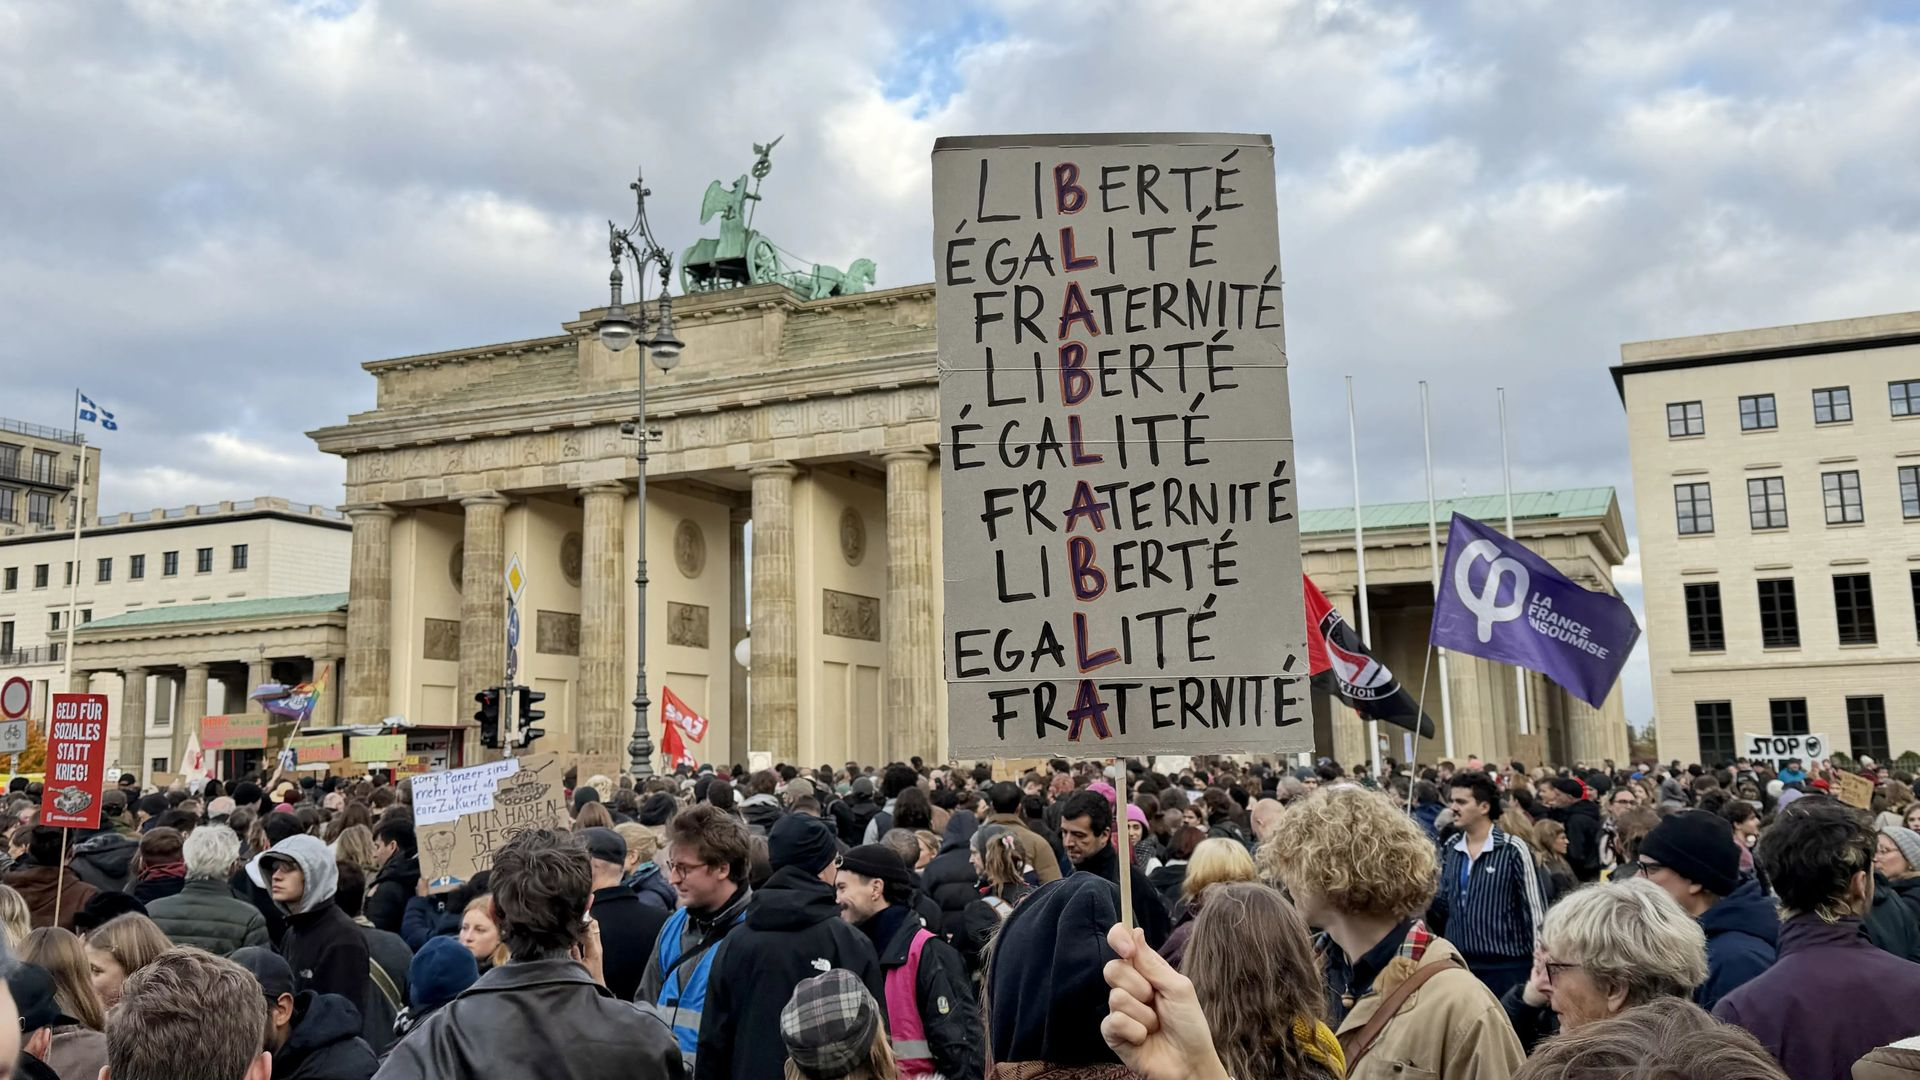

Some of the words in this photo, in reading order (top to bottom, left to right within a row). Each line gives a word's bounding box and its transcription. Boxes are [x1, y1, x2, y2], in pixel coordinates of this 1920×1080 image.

[977, 149, 1244, 223] LIBERTÉ
[946, 205, 1218, 286] ÉGALITÉ
[973, 265, 1283, 344] FRATERNITÉ
[985, 329, 1239, 407] LIBERTÉ
[951, 392, 1211, 471] ÉGALITÉ
[980, 460, 1293, 541] FRATERNITÉ
[995, 529, 1240, 603] LIBERTÉ
[1532, 592, 1552, 609] LA
[1528, 604, 1592, 638] FRANCE
[988, 654, 1303, 742] FRATERNITÉ
[1340, 681, 1376, 698] KTION
[56, 702, 78, 720] GELD
[79, 698, 103, 720] FÜR
[53, 722, 101, 741] SOZIALES
[1749, 737, 1799, 755] STOP
[56, 743, 91, 761] STATT
[55, 763, 89, 782] KRIEG!
[444, 769, 484, 785] Panzer
[486, 763, 509, 776] sind
[415, 783, 447, 800] mehr
[467, 808, 503, 833] WIR
[505, 799, 557, 827] HABEN
